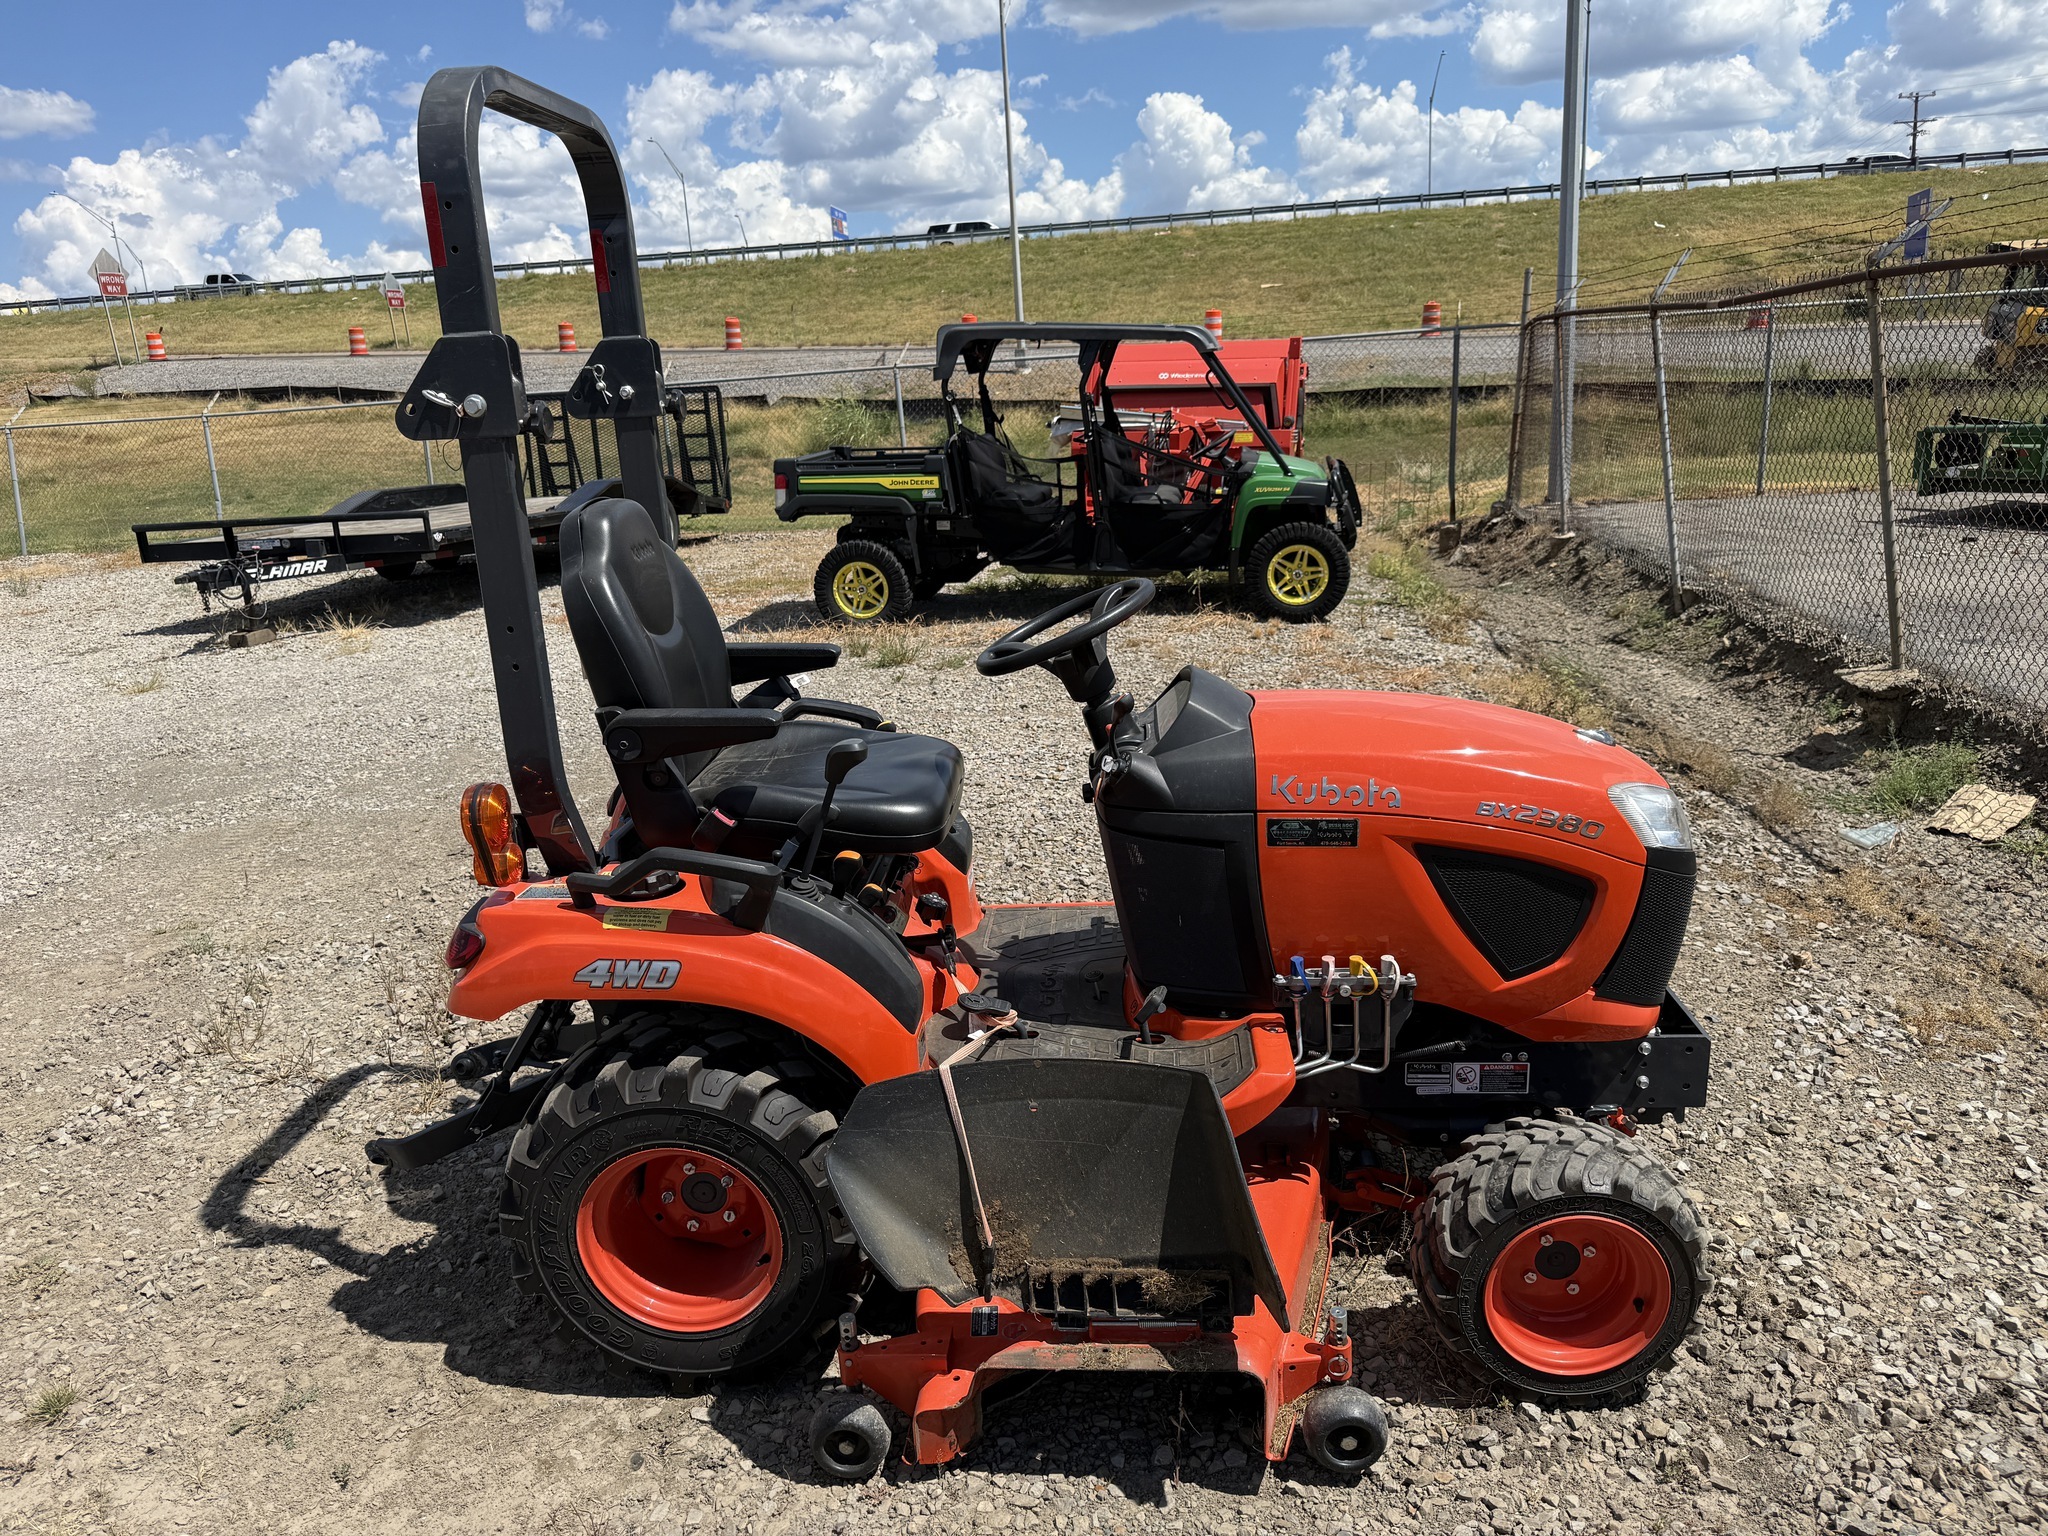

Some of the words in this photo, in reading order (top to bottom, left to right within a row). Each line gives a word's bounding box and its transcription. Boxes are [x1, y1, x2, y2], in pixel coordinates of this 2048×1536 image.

[100, 275, 125, 284] WRONG
[106, 285, 121, 293] WAY
[1271, 774, 1401, 808] Kubota
[1475, 801, 1605, 840] BX2380
[573, 959, 683, 990] 4WD
[675, 1114, 758, 1152] R14T
